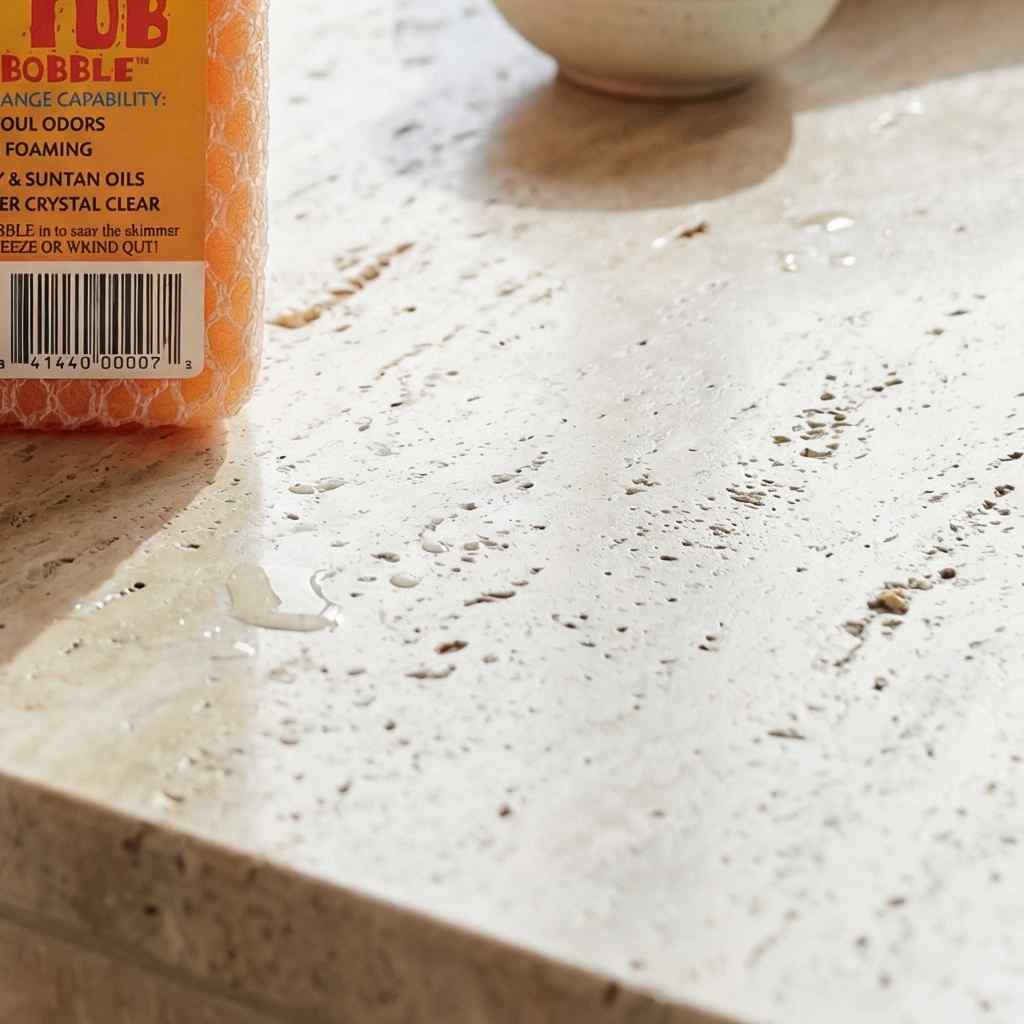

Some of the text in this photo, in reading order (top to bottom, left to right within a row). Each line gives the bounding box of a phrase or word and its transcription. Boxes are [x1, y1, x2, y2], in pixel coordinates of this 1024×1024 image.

[57, 92, 167, 107] CAPABILITY:
[42, 117, 105, 132] ODORS
[5, 142, 92, 157] FOAMING
[9, 173, 21, 186] &
[25, 172, 99, 186] SUNTAN
[105, 172, 144, 186] OILS
[25, 196, 101, 211] CRYSTAL
[105, 196, 160, 211] CLEAR
[40, 225, 50, 236] in
[55, 226, 67, 236] to
[103, 224, 121, 237] the
[41, 241, 63, 253] OR
[30, 356, 91, 369] 41440
[101, 356, 160, 369] 00007
